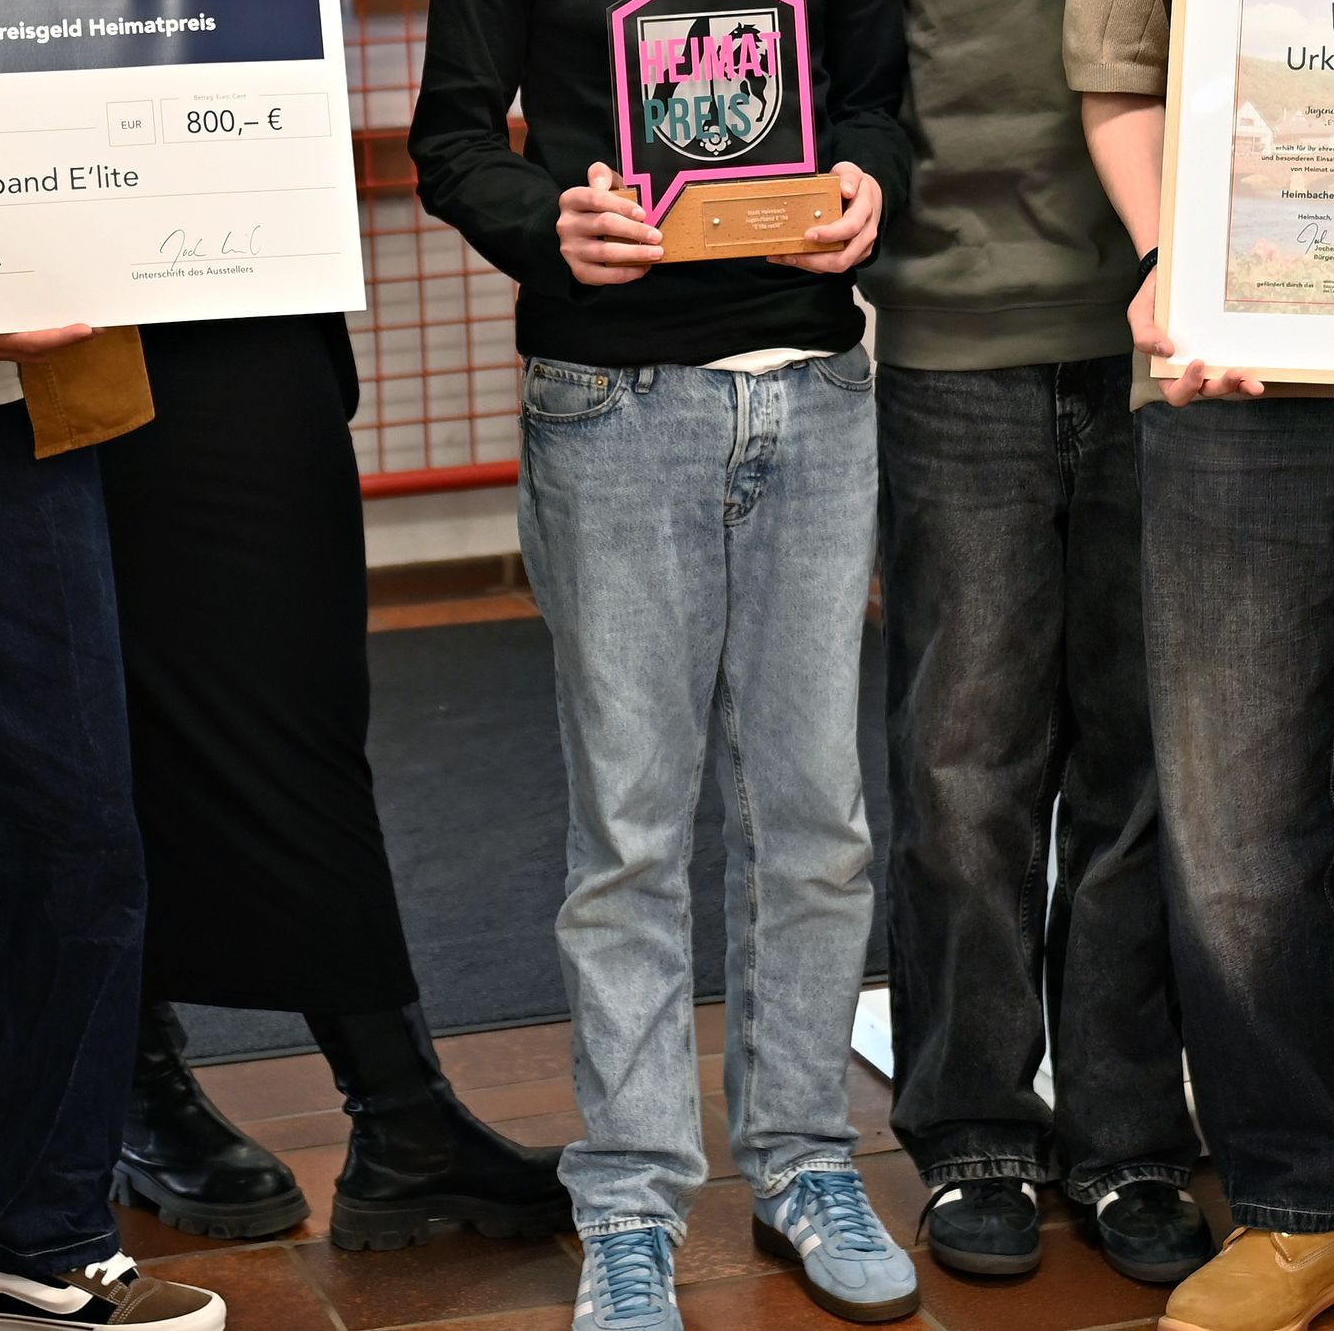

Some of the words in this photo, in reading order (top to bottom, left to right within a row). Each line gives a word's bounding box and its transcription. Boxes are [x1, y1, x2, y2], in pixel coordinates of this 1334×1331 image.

[88, 12, 217, 38] Heimatpreis
[639, 31, 782, 85] HEIMAT
[121, 120, 142, 130] EUR
[267, 107, 283, 131] €
[643, 92, 751, 144] PREIS
[1297, 213, 1332, 221] Heimbach,
[131, 268, 185, 280] Unterschrift
[188, 267, 204, 276] des
[206, 265, 254, 275] Ausstellers
